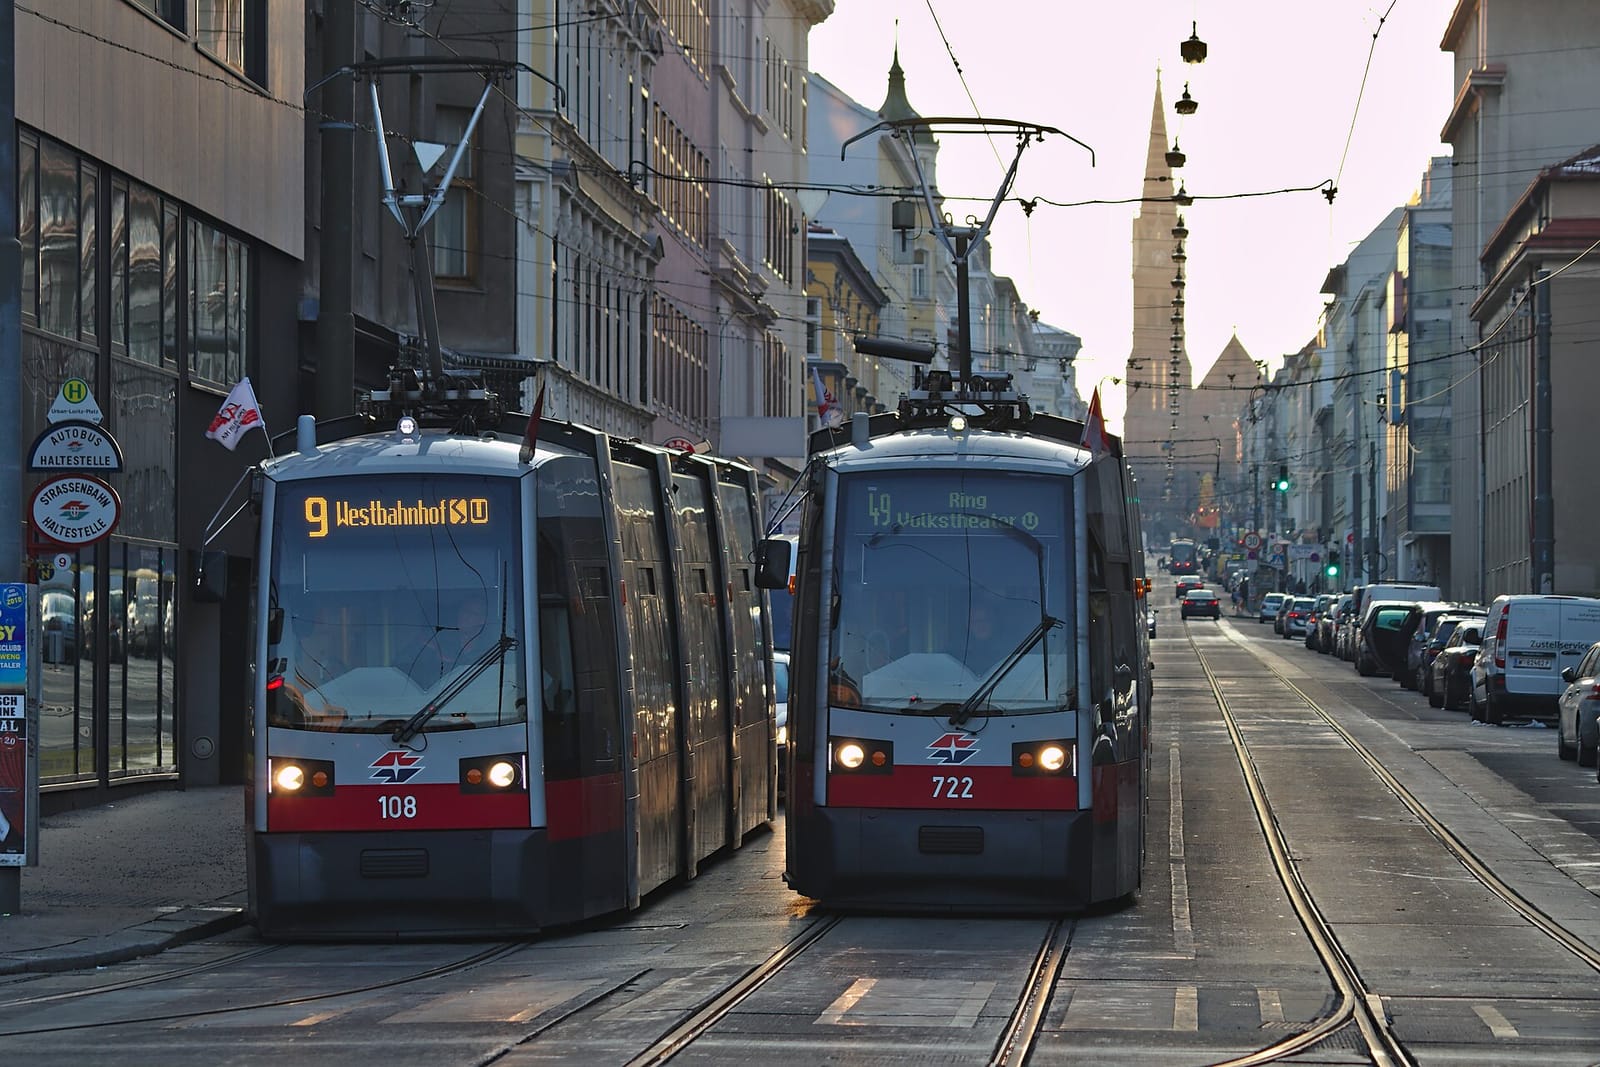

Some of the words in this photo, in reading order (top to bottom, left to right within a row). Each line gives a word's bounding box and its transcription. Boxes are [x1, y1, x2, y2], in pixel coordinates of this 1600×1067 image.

[50, 429, 102, 447] AUTOBUS
[40, 456, 110, 466] HALTESTELLE
[40, 482, 111, 508] STRASSENBAHN
[949, 492, 987, 510] Ring
[304, 496, 329, 538] 9
[336, 499, 447, 527] Westbahnhof
[868, 492, 891, 526] 49
[42, 516, 107, 538] HALTESTELLE
[896, 511, 1016, 529] Volkstheater
[1247, 537, 1258, 546] 30
[58, 557, 67, 567] 9
[41, 569, 50, 579] N
[1530, 640, 1591, 651] Zustellservice
[0, 696, 18, 706] CH
[932, 776, 973, 798] 722
[377, 795, 417, 819] 108
